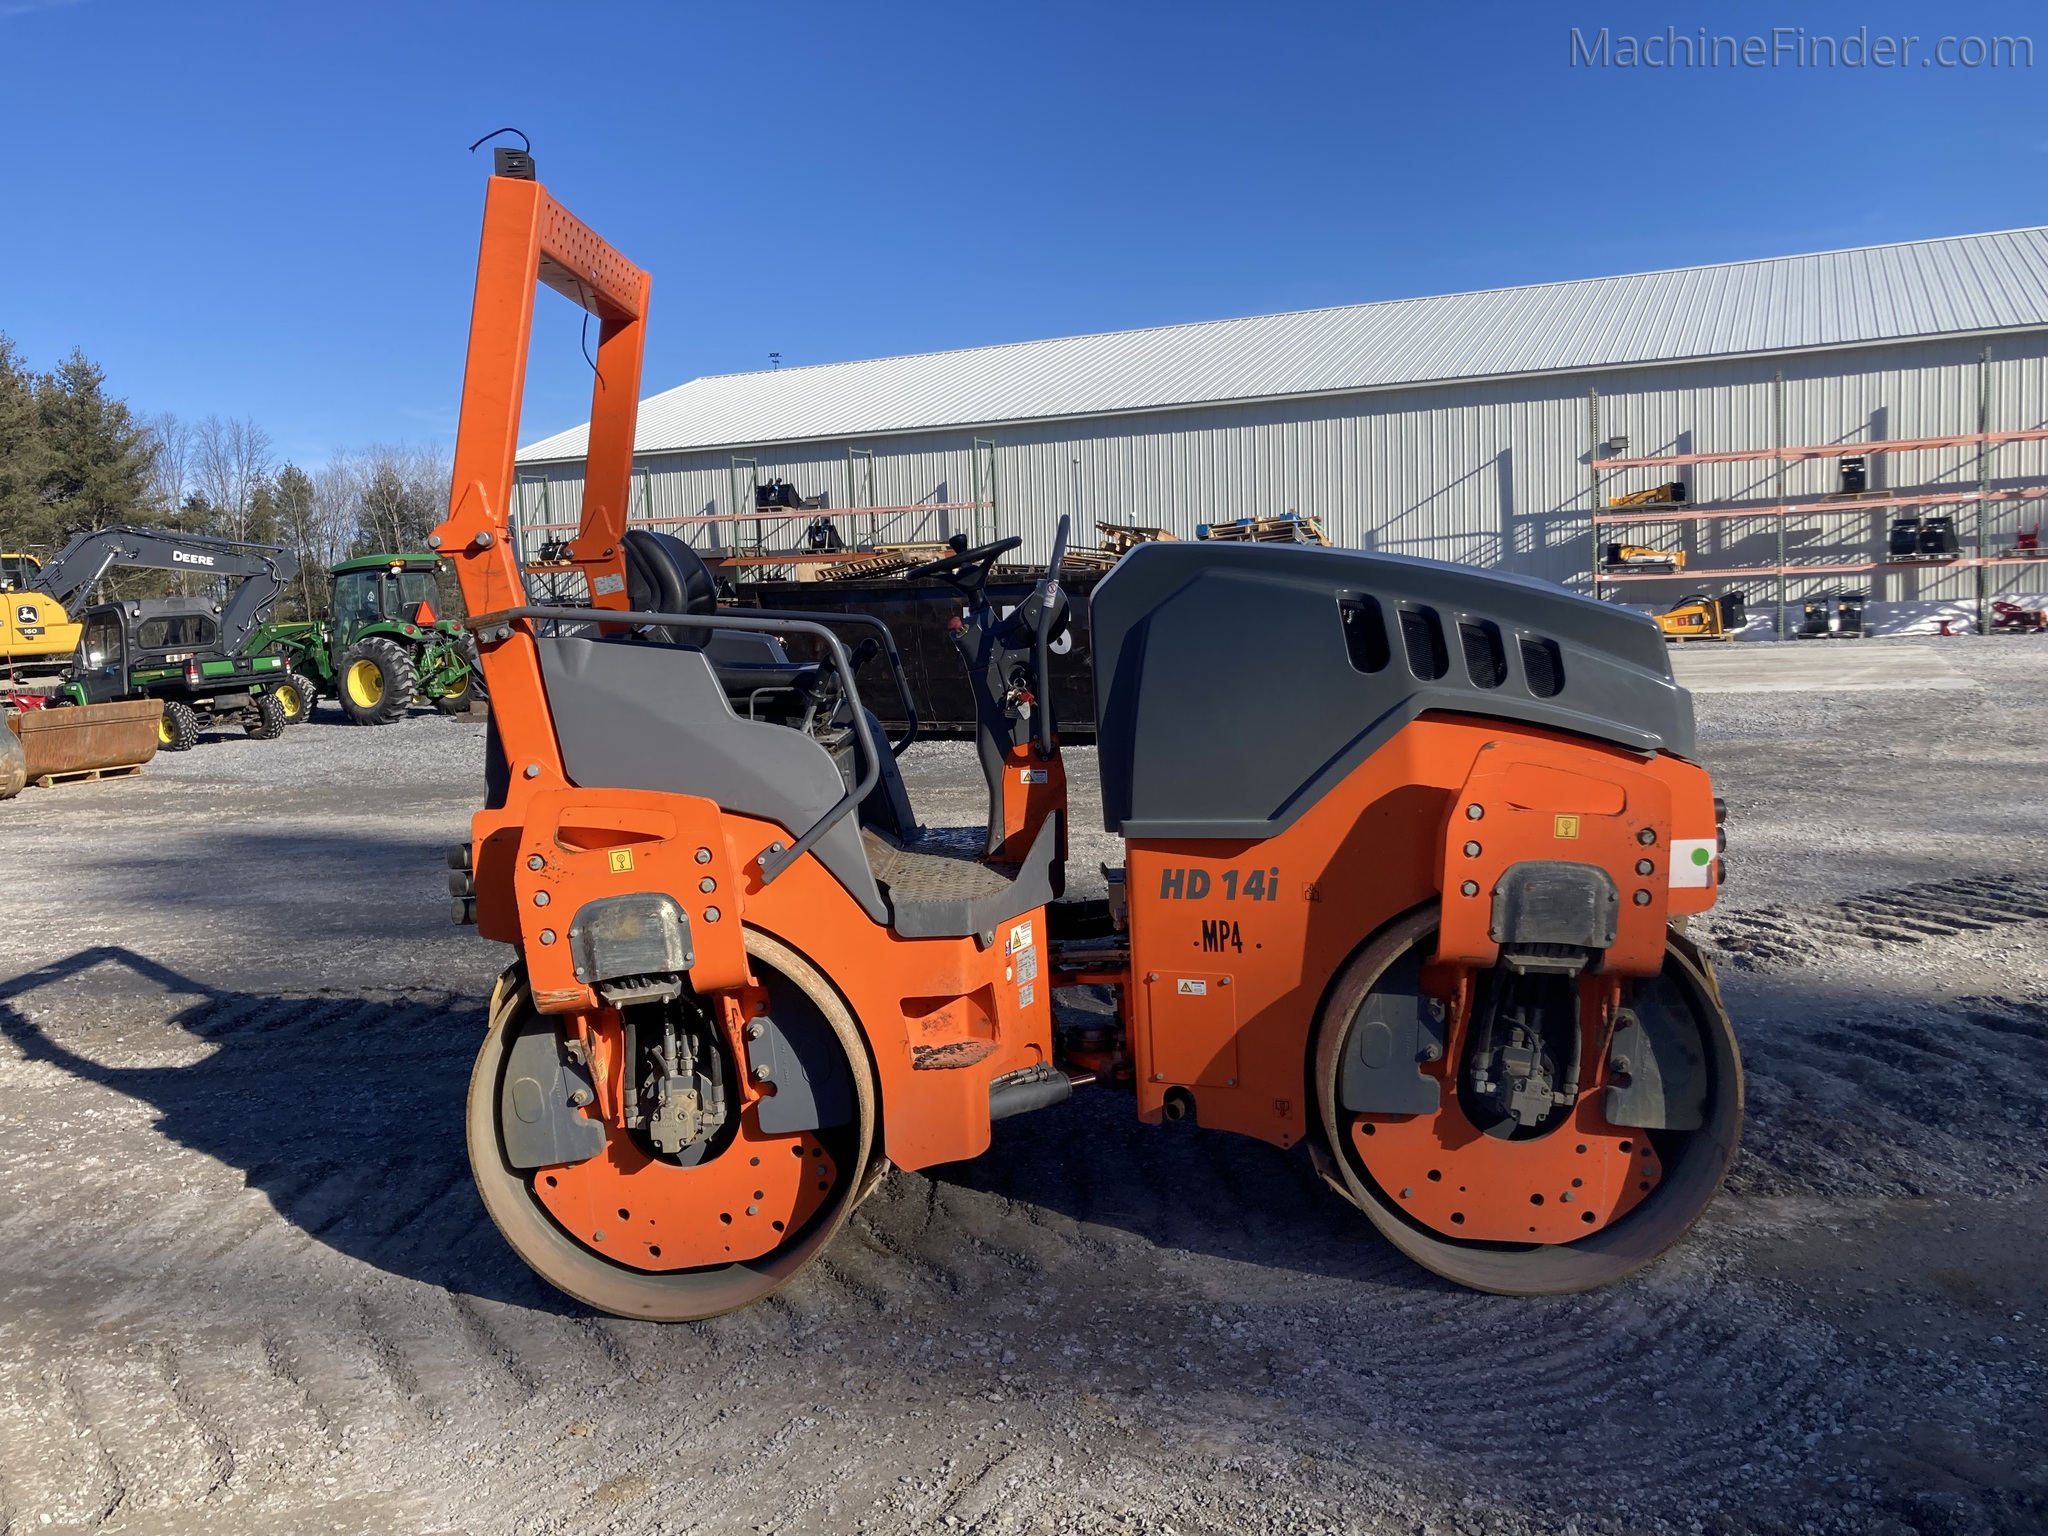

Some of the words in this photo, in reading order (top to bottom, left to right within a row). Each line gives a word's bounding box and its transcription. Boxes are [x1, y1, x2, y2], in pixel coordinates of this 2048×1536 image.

[172, 550, 214, 566] DEERE
[1159, 868, 1211, 900] HD
[1221, 866, 1280, 901] 14i
[1201, 919, 1243, 954] MP4
